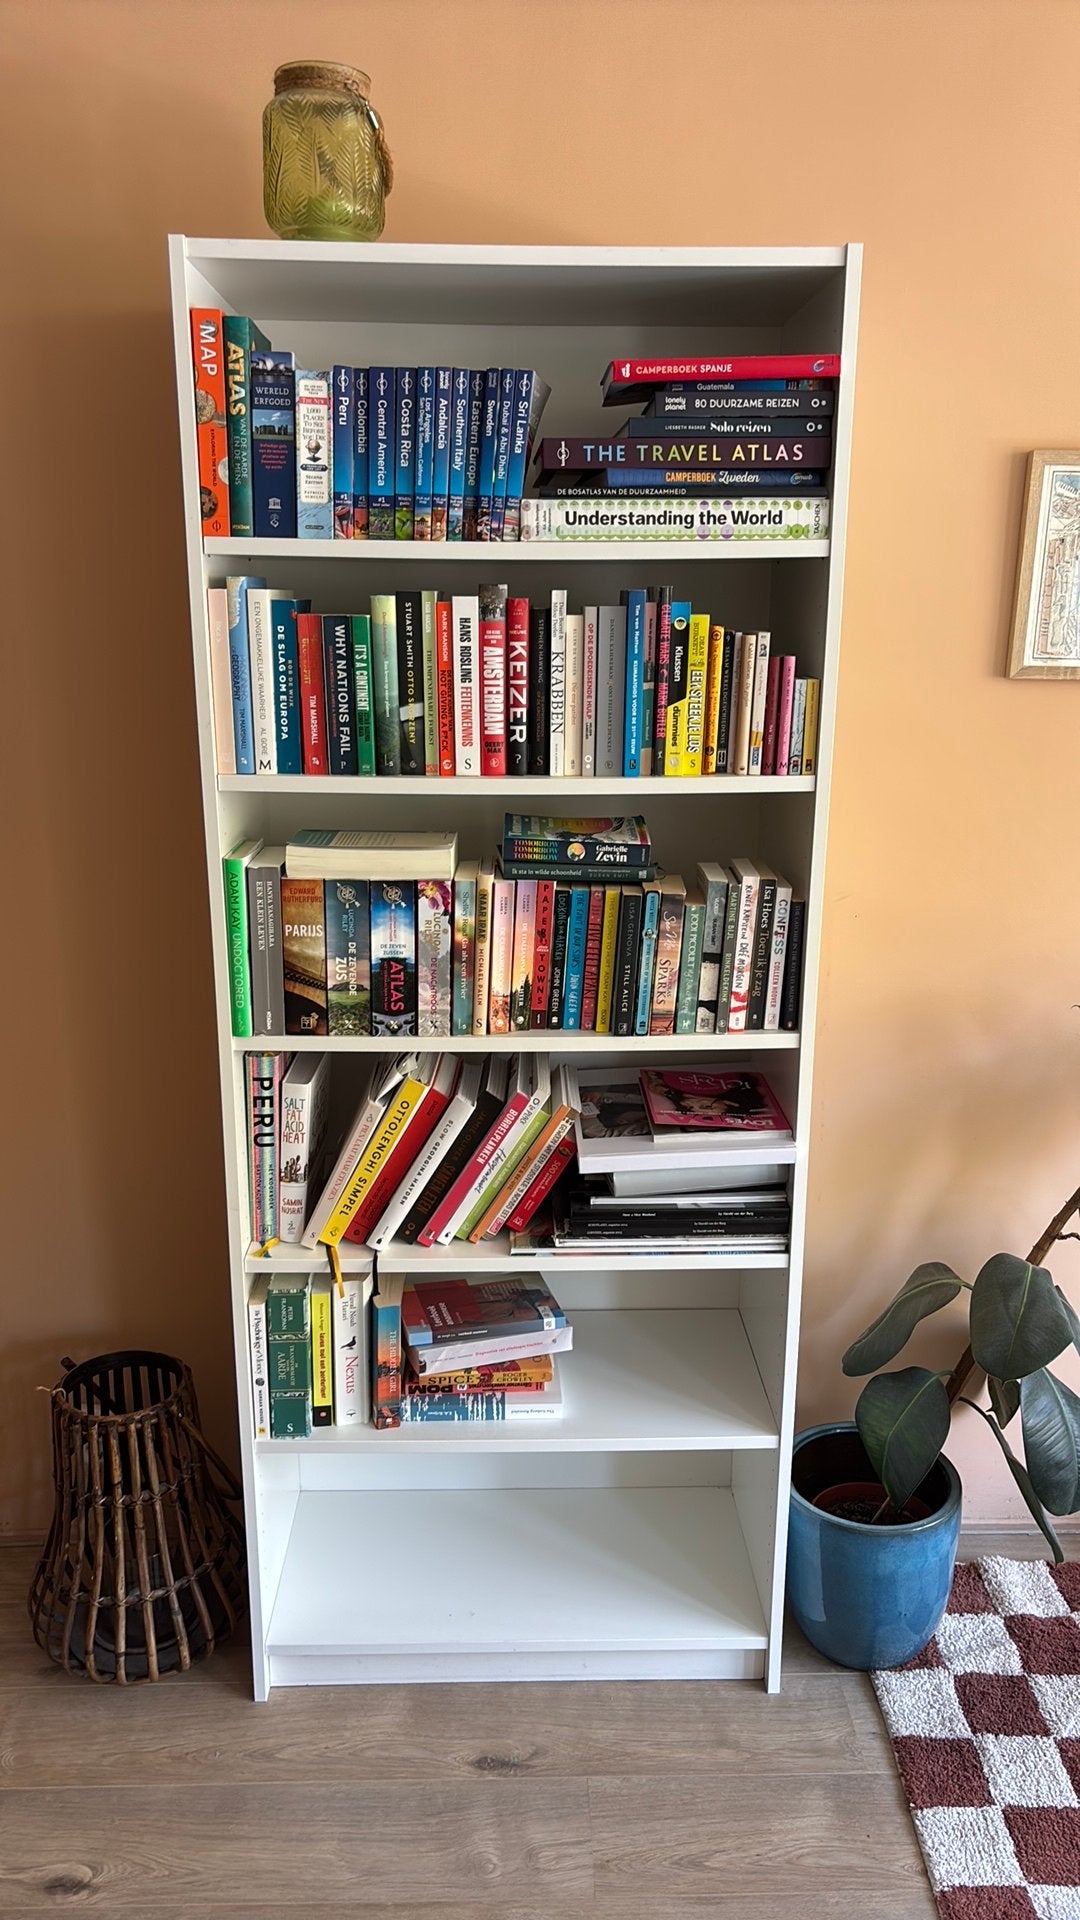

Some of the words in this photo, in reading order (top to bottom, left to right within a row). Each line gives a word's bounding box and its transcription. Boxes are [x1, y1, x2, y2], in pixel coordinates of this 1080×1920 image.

[200, 325, 217, 376] MAP
[227, 342, 246, 415] ATLAS
[636, 364, 697, 375] CAMPERBOEK
[700, 363, 733, 374] SPANJE
[255, 387, 289, 395] WERELD
[697, 383, 734, 391] Guatemala
[255, 398, 291, 406] ERFGOED
[339, 397, 349, 425] Peru
[501, 400, 510, 425] Dubai
[518, 401, 528, 416] Sri
[695, 399, 707, 408] 80
[710, 399, 763, 408] DUURZAME
[766, 398, 799, 407] REIZEN
[357, 400, 367, 453] Colombia
[377, 400, 387, 439] Central
[401, 399, 412, 436] Costa
[455, 399, 465, 446] Southern
[470, 401, 481, 444] Eastern
[486, 400, 495, 436] Sweden
[710, 421, 734, 433] Solo
[737, 421, 771, 433] reizen
[514, 420, 525, 454] Lanka
[377, 442, 386, 486] America
[400, 440, 411, 467] Rica
[452, 449, 463, 471] Italy
[584, 445, 626, 462] THE
[637, 445, 721, 461] TRAVEL
[732, 445, 803, 461] ATLAS
[466, 447, 479, 486] Europe
[498, 455, 506, 479] Dhabi
[665, 472, 716, 483] CAMPERBOEK
[719, 471, 760, 483] Zweden
[557, 488, 566, 496] DE
[567, 488, 601, 496] BOSATLAS
[602, 488, 617, 496] VAN
[618, 488, 628, 496] DE
[629, 488, 686, 496] DUURZAAMHEID
[565, 511, 694, 528] Understanding
[699, 511, 727, 525] the
[731, 510, 783, 525] World
[277, 626, 285, 641] DE
[334, 625, 346, 656] WHY
[459, 617, 471, 643] HANS
[588, 623, 594, 633] OP
[588, 635, 593, 645] DE
[254, 617, 264, 682] ONGEMAKKELIJKE
[278, 644, 286, 671] SLAG
[460, 645, 471, 683] ROSLING
[673, 646, 683, 682] Klussen
[232, 654, 240, 701] GEOGRAPHY
[278, 675, 286, 692] OM
[690, 670, 702, 688] EEN
[258, 683, 266, 720] WAARHEID
[336, 660, 348, 722] NATIONS
[483, 646, 504, 735] AMSTERDAM
[509, 641, 526, 743] KEIZER
[551, 651, 564, 734] KRABBEN
[279, 695, 288, 740] EUROPA
[461, 686, 473, 747] FEITENKENNIS
[688, 689, 702, 733] STEEKJE
[310, 709, 318, 745] MARSHALL
[340, 727, 350, 755] FAIL
[687, 734, 700, 753] LOS
[595, 852, 627, 862] Zevin
[230, 872, 240, 904] ADAM
[282, 895, 323, 903] RUTHERFURD
[289, 887, 316, 895] EDWARD
[763, 886, 774, 899] Isa
[479, 894, 487, 916] NAAR
[728, 892, 737, 922] MARTINE
[761, 903, 773, 928] Hoes
[231, 907, 240, 930] KAY
[285, 924, 323, 937] PARIJS
[478, 920, 486, 941] IRAK
[773, 899, 788, 955] CONFESS
[433, 912, 441, 952] LUCINDA
[726, 925, 734, 940] BIJL
[758, 931, 769, 956] Toen
[348, 942, 356, 954] DE
[233, 933, 244, 1008] UNDOCTORED
[335, 957, 346, 981] ZUS
[755, 969, 765, 978] je
[757, 958, 767, 967] ik
[772, 962, 781, 985] COLLEEN
[349, 956, 357, 996] ZEVENDE
[390, 962, 404, 1011] ATLAS
[553, 967, 561, 986] JOHN
[656, 959, 671, 1005] SPARKS
[721, 953, 732, 1003] RINKELDEKINK
[752, 980, 762, 997] zag
[551, 988, 560, 1012] GREEN
[621, 989, 629, 1012] ALICE
[770, 986, 779, 1008] HOOVER
[253, 1077, 274, 1148] PERU
[284, 1098, 306, 1110] SALT
[286, 1109, 302, 1120] FAT
[283, 1132, 306, 1144] HEAT
[285, 1120, 304, 1132] ACID
[363, 1098, 410, 1174] OTTOLENGHI
[438, 1118, 454, 1140] SLOW
[475, 1106, 518, 1166] BORRELPLANKEN
[416, 1140, 440, 1177] GEORGINA
[548, 1158, 560, 1174] 500
[282, 1198, 303, 1206] SAMIN
[338, 1175, 367, 1219] SIMPEL
[398, 1177, 418, 1206] HAYDEN
[282, 1206, 304, 1215] NOSRAT
[278, 1352, 286, 1380] AARDE
[345, 1356, 358, 1394] Nexus
[408, 1384, 453, 1393] POM
[428, 1376, 474, 1384] SPICE
